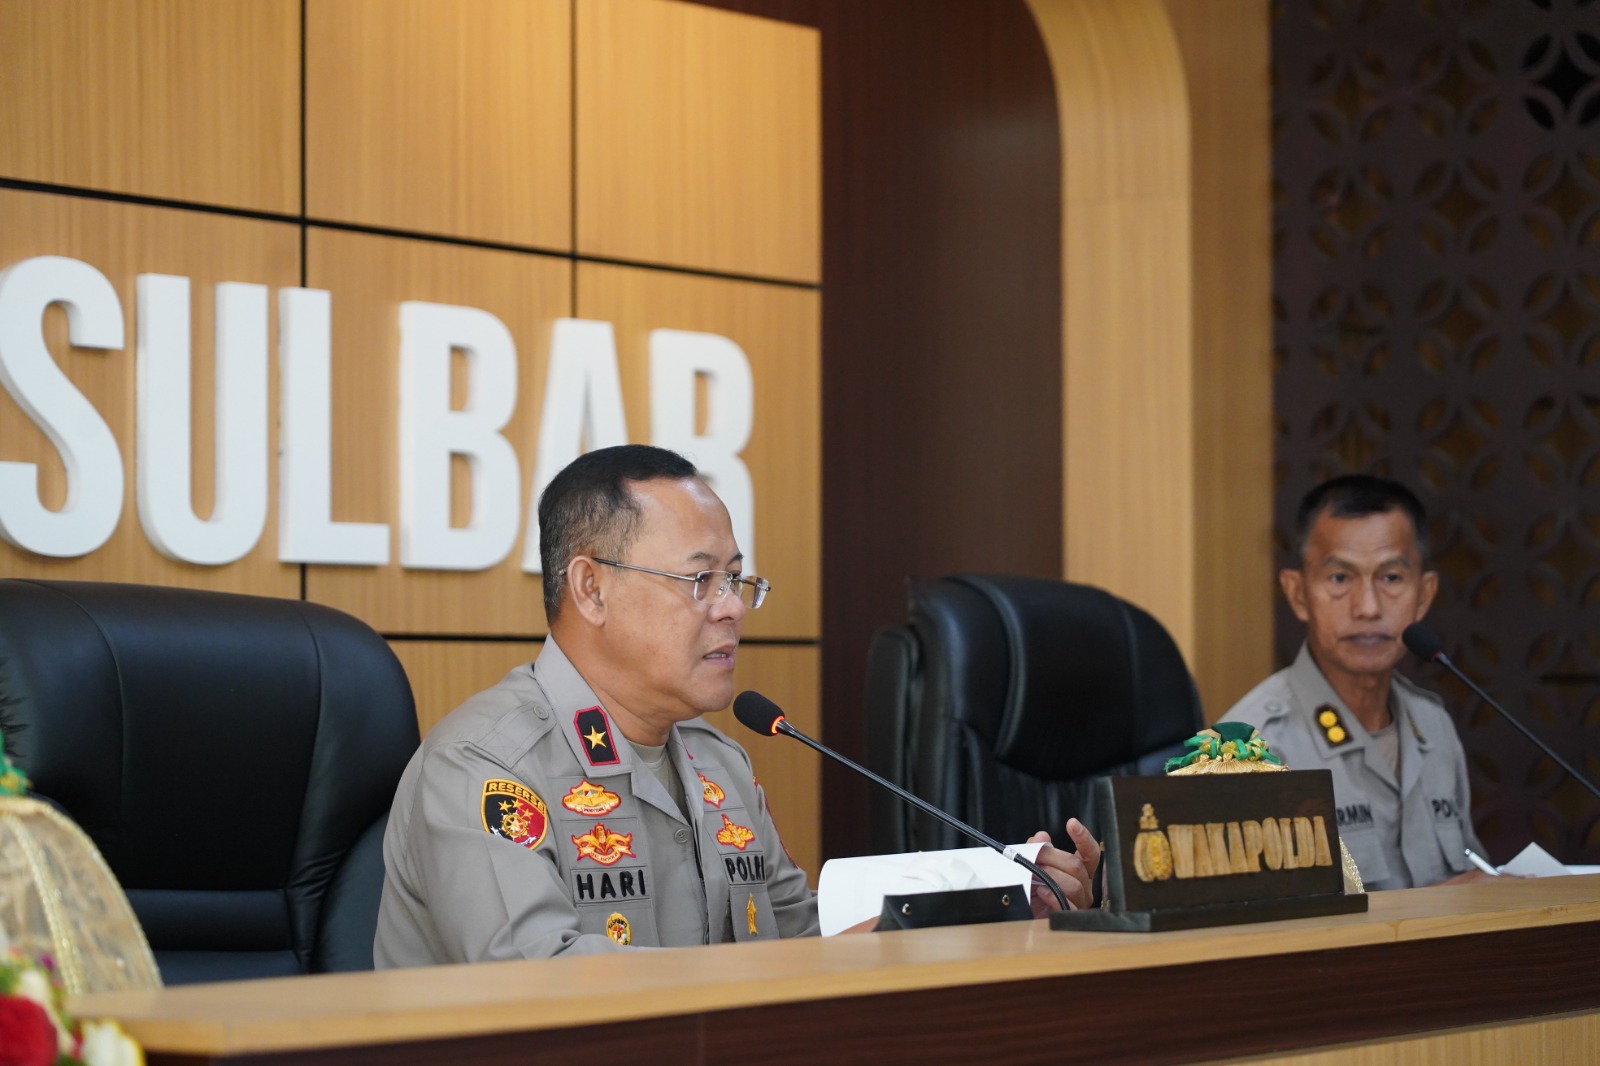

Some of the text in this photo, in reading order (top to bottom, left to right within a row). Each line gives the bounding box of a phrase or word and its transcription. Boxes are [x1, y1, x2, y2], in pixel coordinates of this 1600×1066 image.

[0, 255, 755, 575] SULBAR
[724, 855, 765, 882] POLRI
[1167, 815, 1333, 879] WAKAPOLDA
[576, 869, 646, 900] HARI
